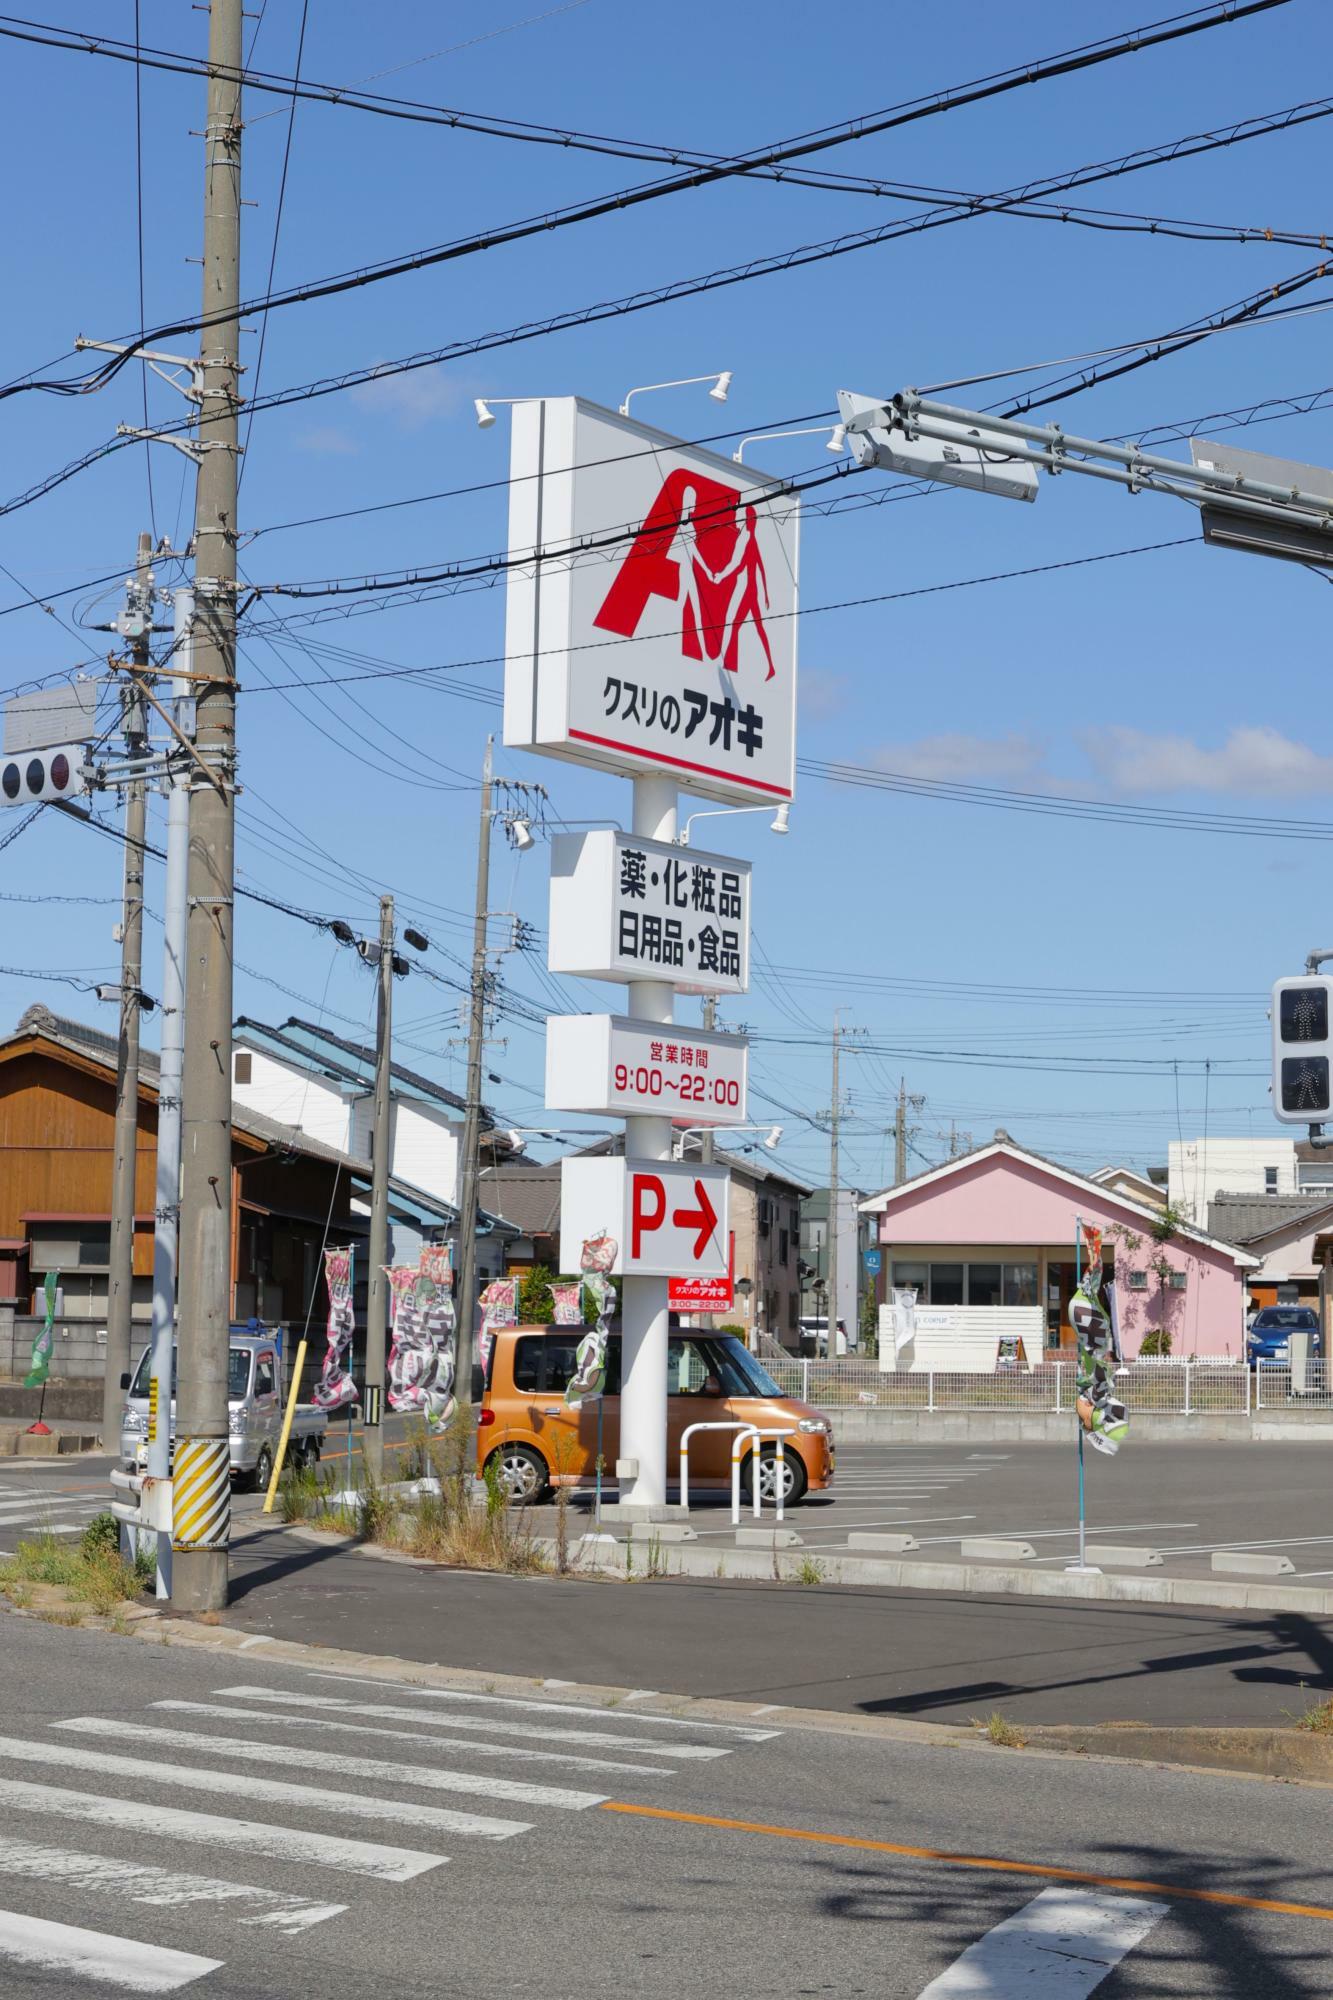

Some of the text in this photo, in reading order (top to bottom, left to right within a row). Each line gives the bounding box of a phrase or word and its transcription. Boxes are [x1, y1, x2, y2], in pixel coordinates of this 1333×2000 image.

[603, 676, 763, 758] クスリのアオキ
[620, 848, 742, 920] 薬・化粧品
[619, 909, 741, 978] 日用品・食品
[615, 1064, 740, 1106] 9:00~22:00
[650, 1041, 709, 1069] 営業時間
[631, 1173, 666, 1260] P
[675, 1286, 727, 1298] クスリのアオキ
